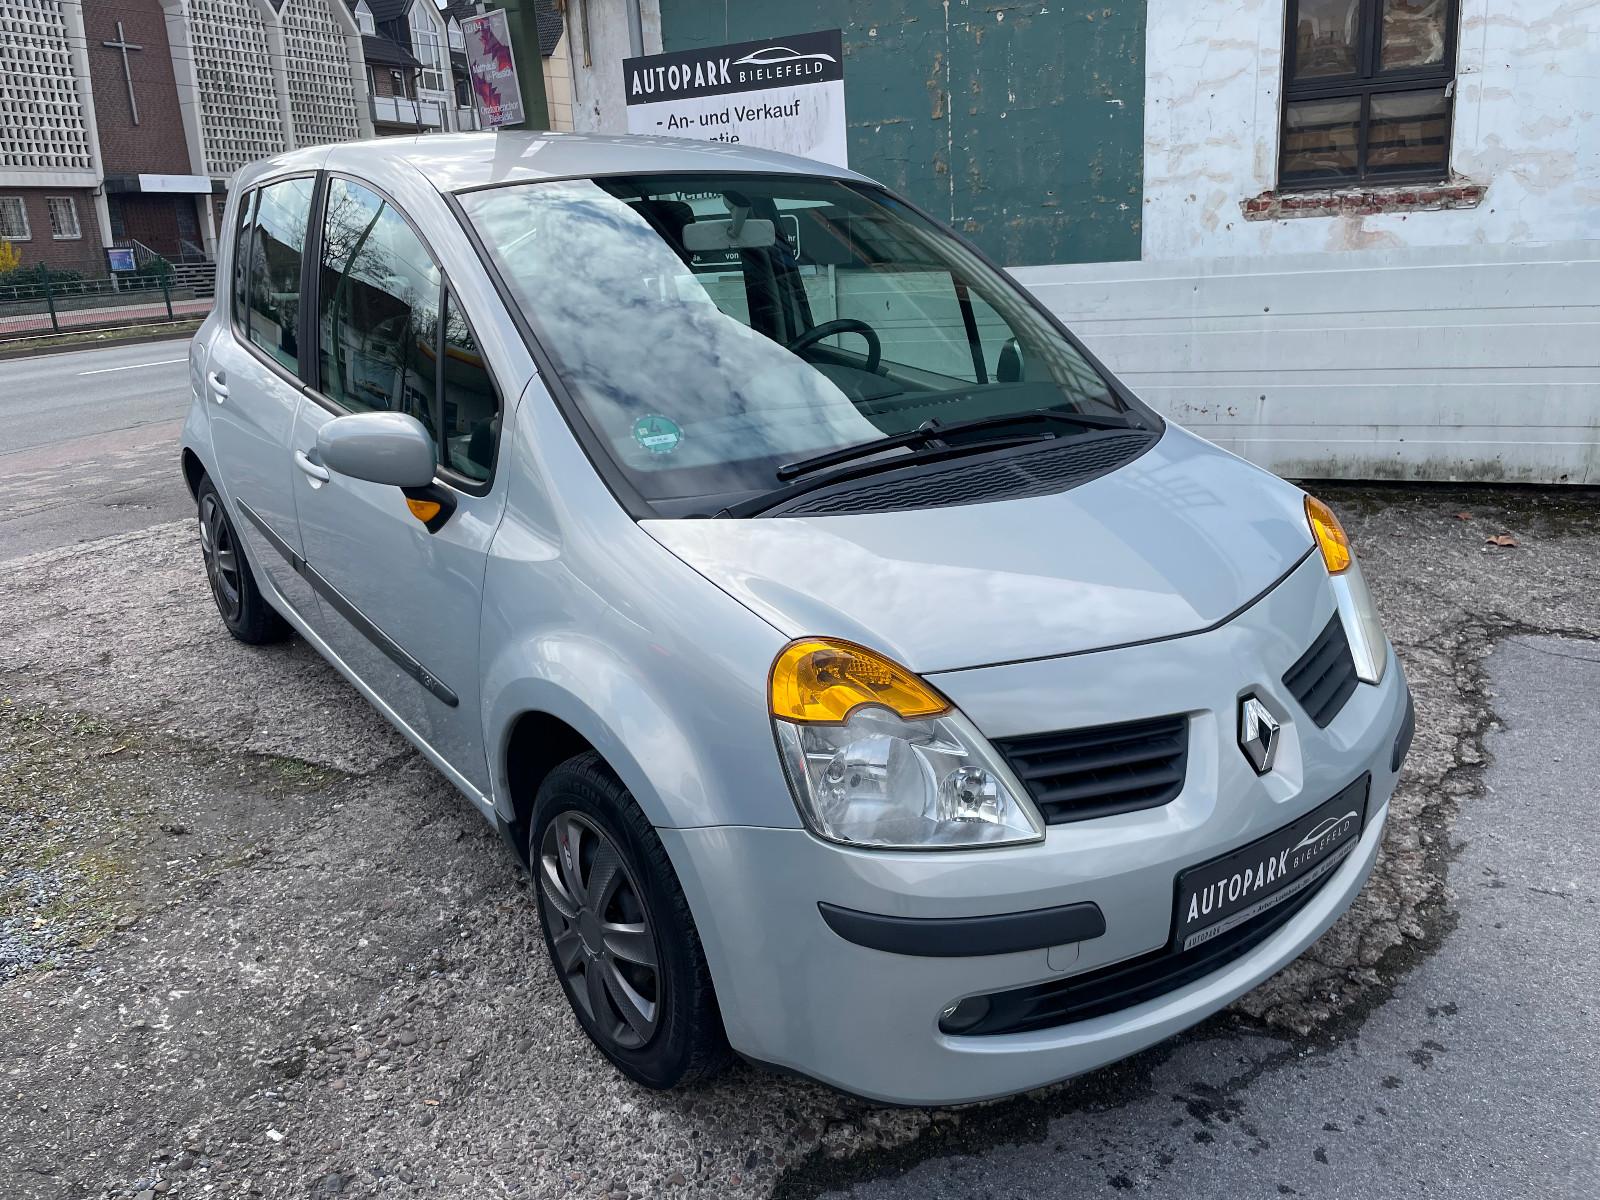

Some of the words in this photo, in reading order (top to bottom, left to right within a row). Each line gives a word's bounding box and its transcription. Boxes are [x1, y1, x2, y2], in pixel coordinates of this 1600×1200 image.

[632, 58, 732, 96] AUTOPARK
[739, 61, 824, 83] BIELEFELD
[667, 113, 695, 130] An-
[699, 108, 730, 127] und
[735, 99, 801, 123] Verkauf
[725, 251, 740, 260] von
[1187, 848, 1290, 924] AUTOPARK
[1293, 820, 1351, 869] BIELEFELD
